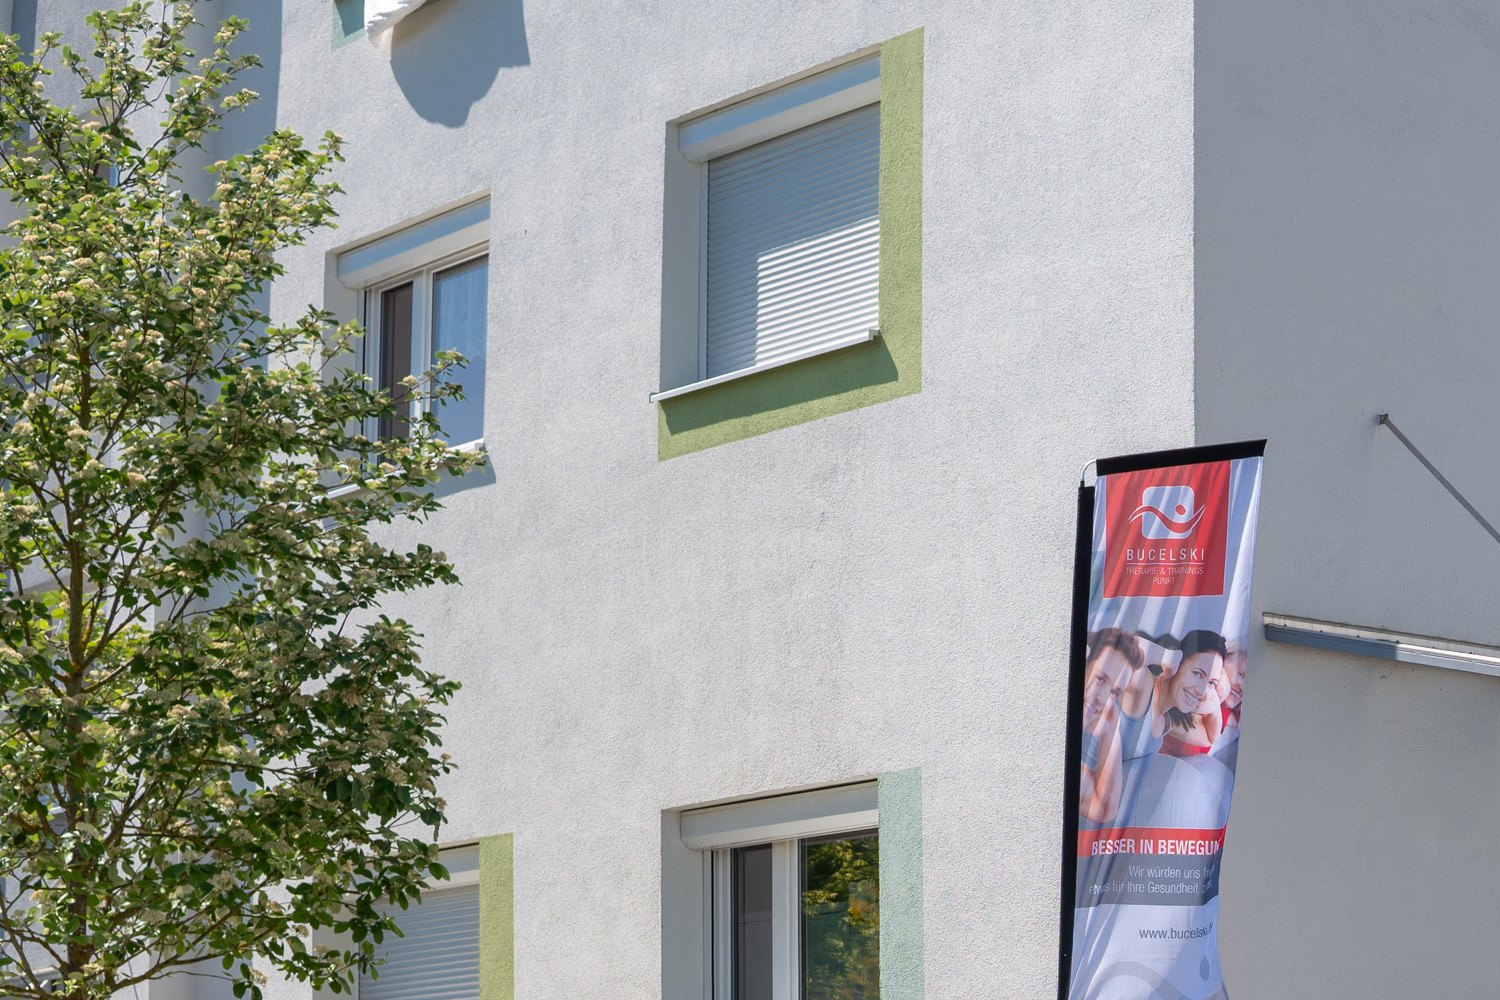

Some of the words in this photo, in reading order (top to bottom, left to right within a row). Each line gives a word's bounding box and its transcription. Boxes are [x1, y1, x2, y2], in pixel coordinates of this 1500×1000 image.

[1126, 549, 1204, 561] BUCELSKI
[1126, 567, 1158, 575] THERAPIE
[1160, 567, 1166, 575] &
[1153, 577, 1175, 585] PUNKT
[1091, 839, 1135, 856] BESSER
[1140, 840, 1153, 854] IN
[1129, 865, 1144, 877] Wir
[1147, 866, 1181, 879] würden
[1184, 869, 1200, 879] uns
[1112, 880, 1125, 892] für
[1128, 881, 1144, 893] Ihre
[1148, 882, 1199, 894] Gesundheit
